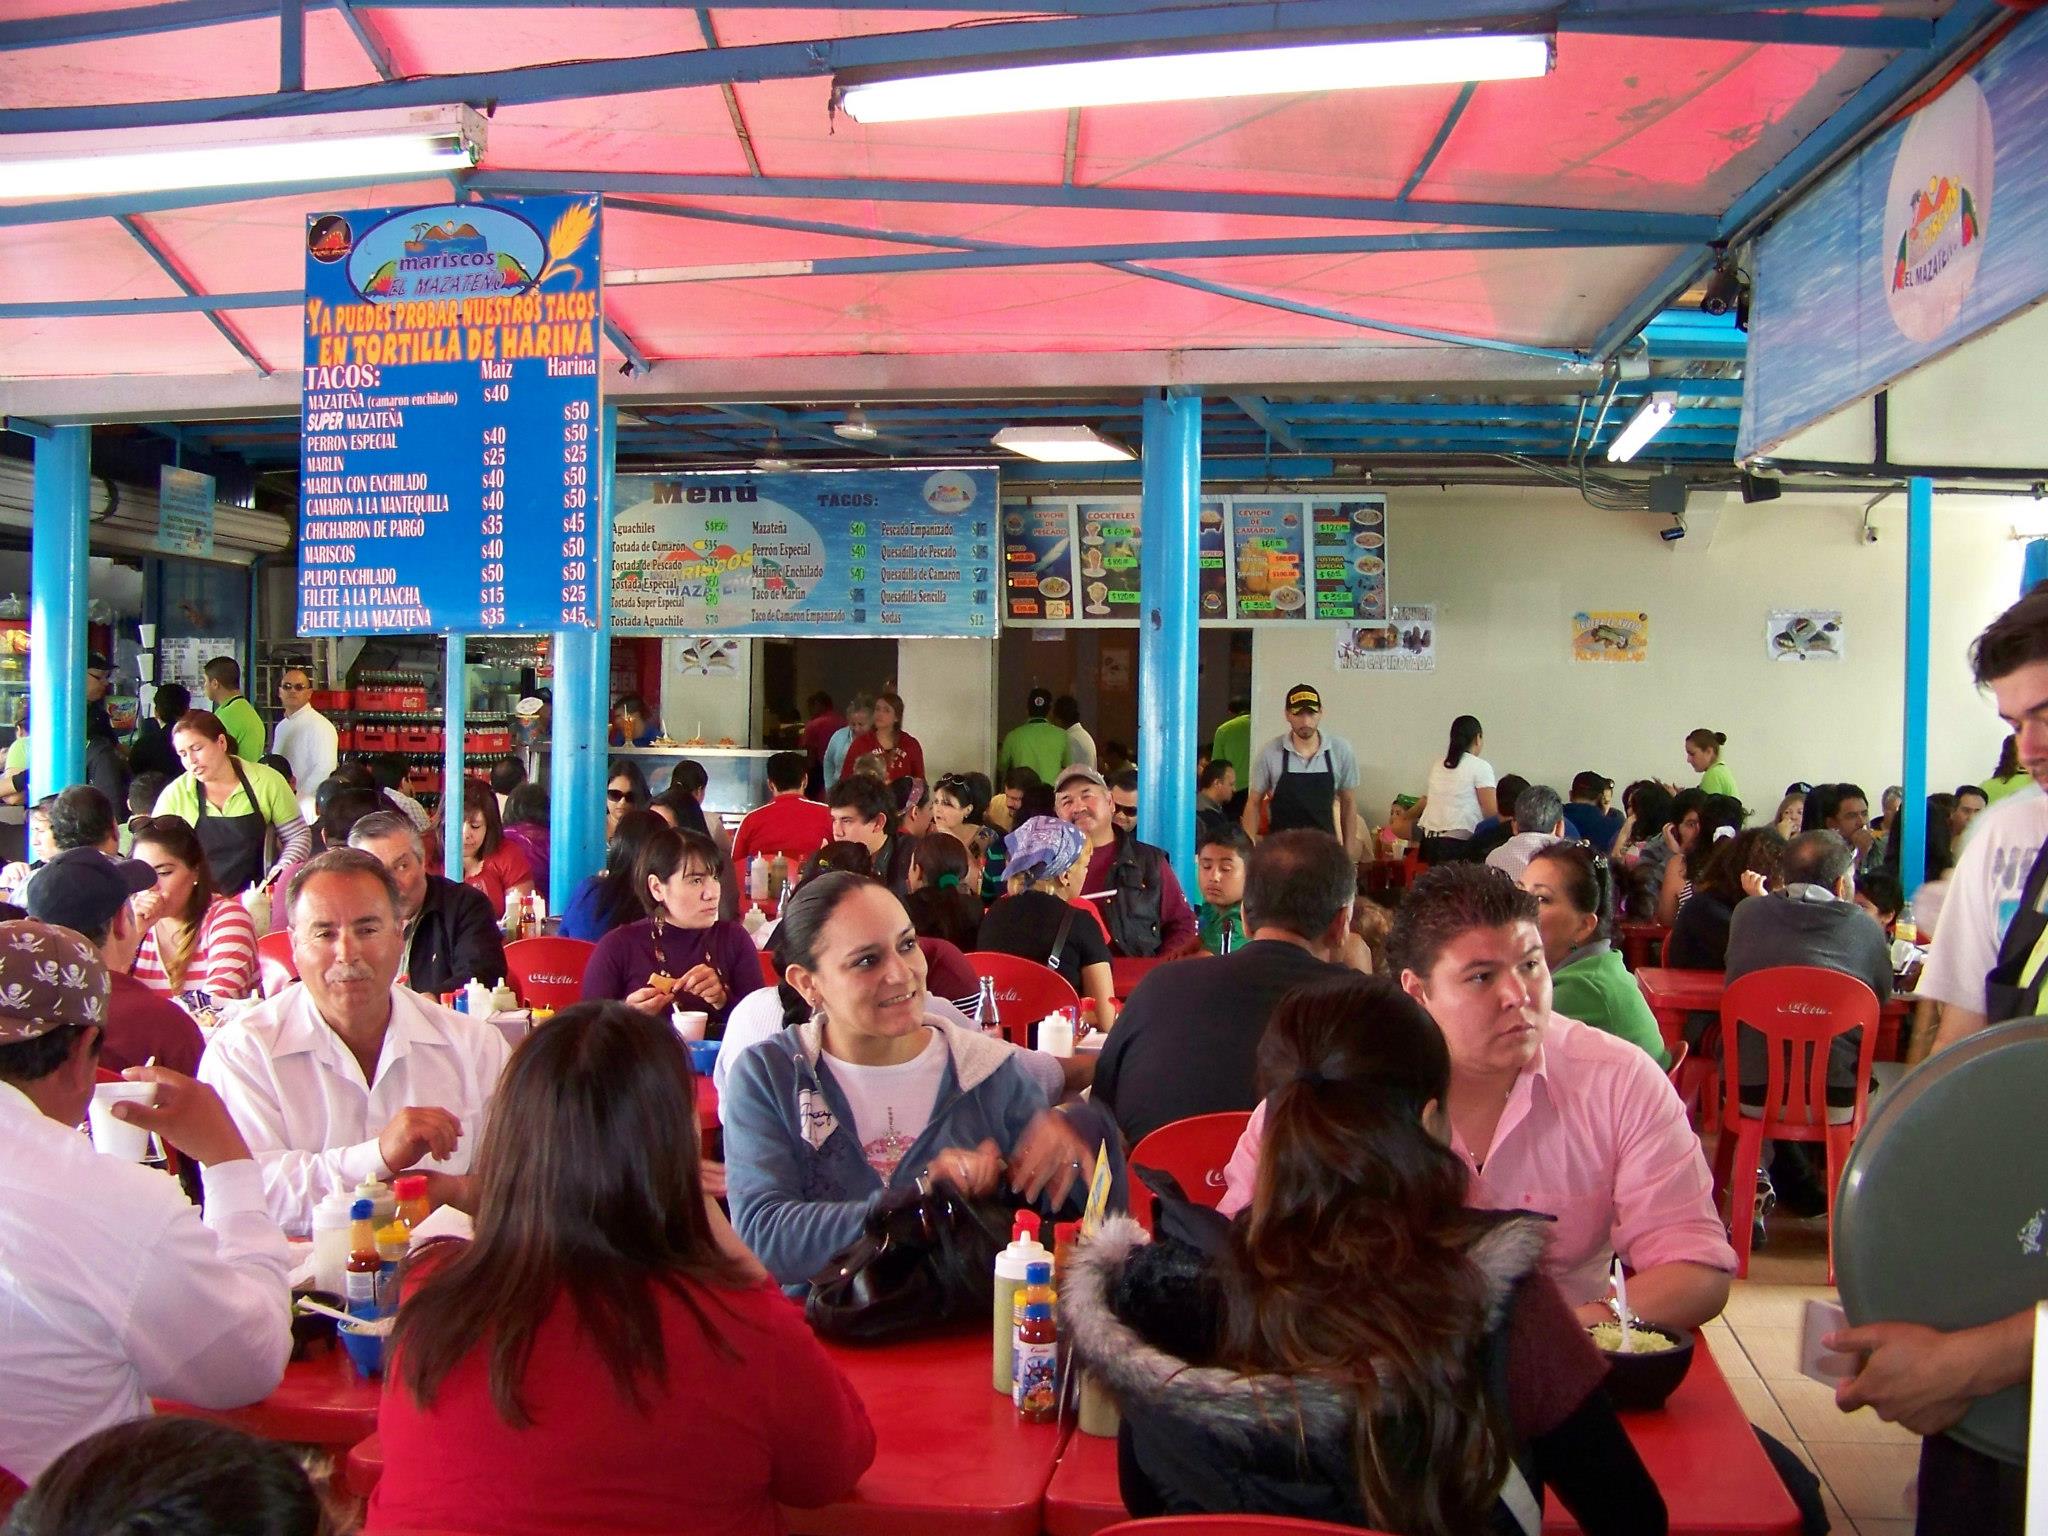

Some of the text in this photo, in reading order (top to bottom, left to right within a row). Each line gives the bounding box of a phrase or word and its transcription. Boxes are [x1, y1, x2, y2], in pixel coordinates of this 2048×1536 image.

[400, 250, 496, 271] mariscos
[334, 303, 392, 335] PUEDES
[394, 299, 459, 331] PROBAR
[462, 294, 542, 328] NUESTROS
[544, 291, 596, 322] TACOS
[319, 320, 594, 368] EN TORTILLA DE HARINA
[305, 356, 597, 390] TACOS: Maiz Harina
[308, 389, 365, 411] MAZATEÑA
[411, 391, 458, 407] enchilado)
[307, 411, 343, 432] SUPER
[346, 408, 404, 430] MAZATEÑA
[307, 435, 348, 453] PERRON
[350, 433, 398, 451] ESPECIAL
[306, 456, 345, 473] MARLIN
[306, 477, 343, 495] MARLIN
[346, 475, 369, 494] CON
[370, 473, 428, 493] ENCHILADO
[653, 479, 758, 504] Menú
[306, 498, 354, 517] CAMARON
[356, 497, 363, 515] A
[364, 496, 379, 515] LA
[380, 494, 449, 517] MANTEQUILLA
[817, 493, 879, 506] TACOS:
[306, 520, 371, 541] CHICHARRON
[374, 519, 388, 538] DE
[389, 518, 425, 538] PARGO
[612, 521, 656, 537] Aguachiles
[881, 523, 909, 536] Pescado
[910, 522, 954, 538] Empanizado
[304, 544, 356, 564] MARISCOS
[612, 541, 641, 553] Tostada
[642, 540, 650, 552] de
[780, 542, 811, 559] Especial
[881, 545, 918, 561] Quesadilla
[919, 545, 928, 558] de
[929, 545, 957, 558] Pescado
[612, 559, 641, 572] Tostada
[642, 559, 651, 571] de
[652, 559, 683, 572] Pescado
[786, 564, 824, 578] Enchilado
[304, 569, 337, 587] PULPO
[339, 567, 396, 586] ENCHILADO
[881, 567, 918, 583] Quesadilla
[919, 567, 927, 580] de
[611, 578, 641, 590] Tostada
[643, 577, 677, 593] Especial
[752, 587, 769, 600] Taco
[770, 587, 779, 600] de
[304, 588, 340, 607] FILETE
[343, 589, 350, 606] A
[353, 588, 367, 606] LA
[369, 586, 421, 606] PLANCHA
[611, 597, 636, 608] Tostada
[637, 597, 656, 610] Super
[657, 597, 685, 610] Especial
[881, 589, 917, 605] Quesadilla
[303, 611, 339, 629] FILETE
[343, 611, 350, 628] A
[353, 610, 368, 628] LA
[370, 605, 432, 628] MAZATEÑA
[611, 615, 641, 627] Tostada
[643, 615, 684, 629] Aguachile
[751, 609, 766, 622] Taco
[767, 609, 775, 622] de
[881, 611, 902, 624] Sodas
